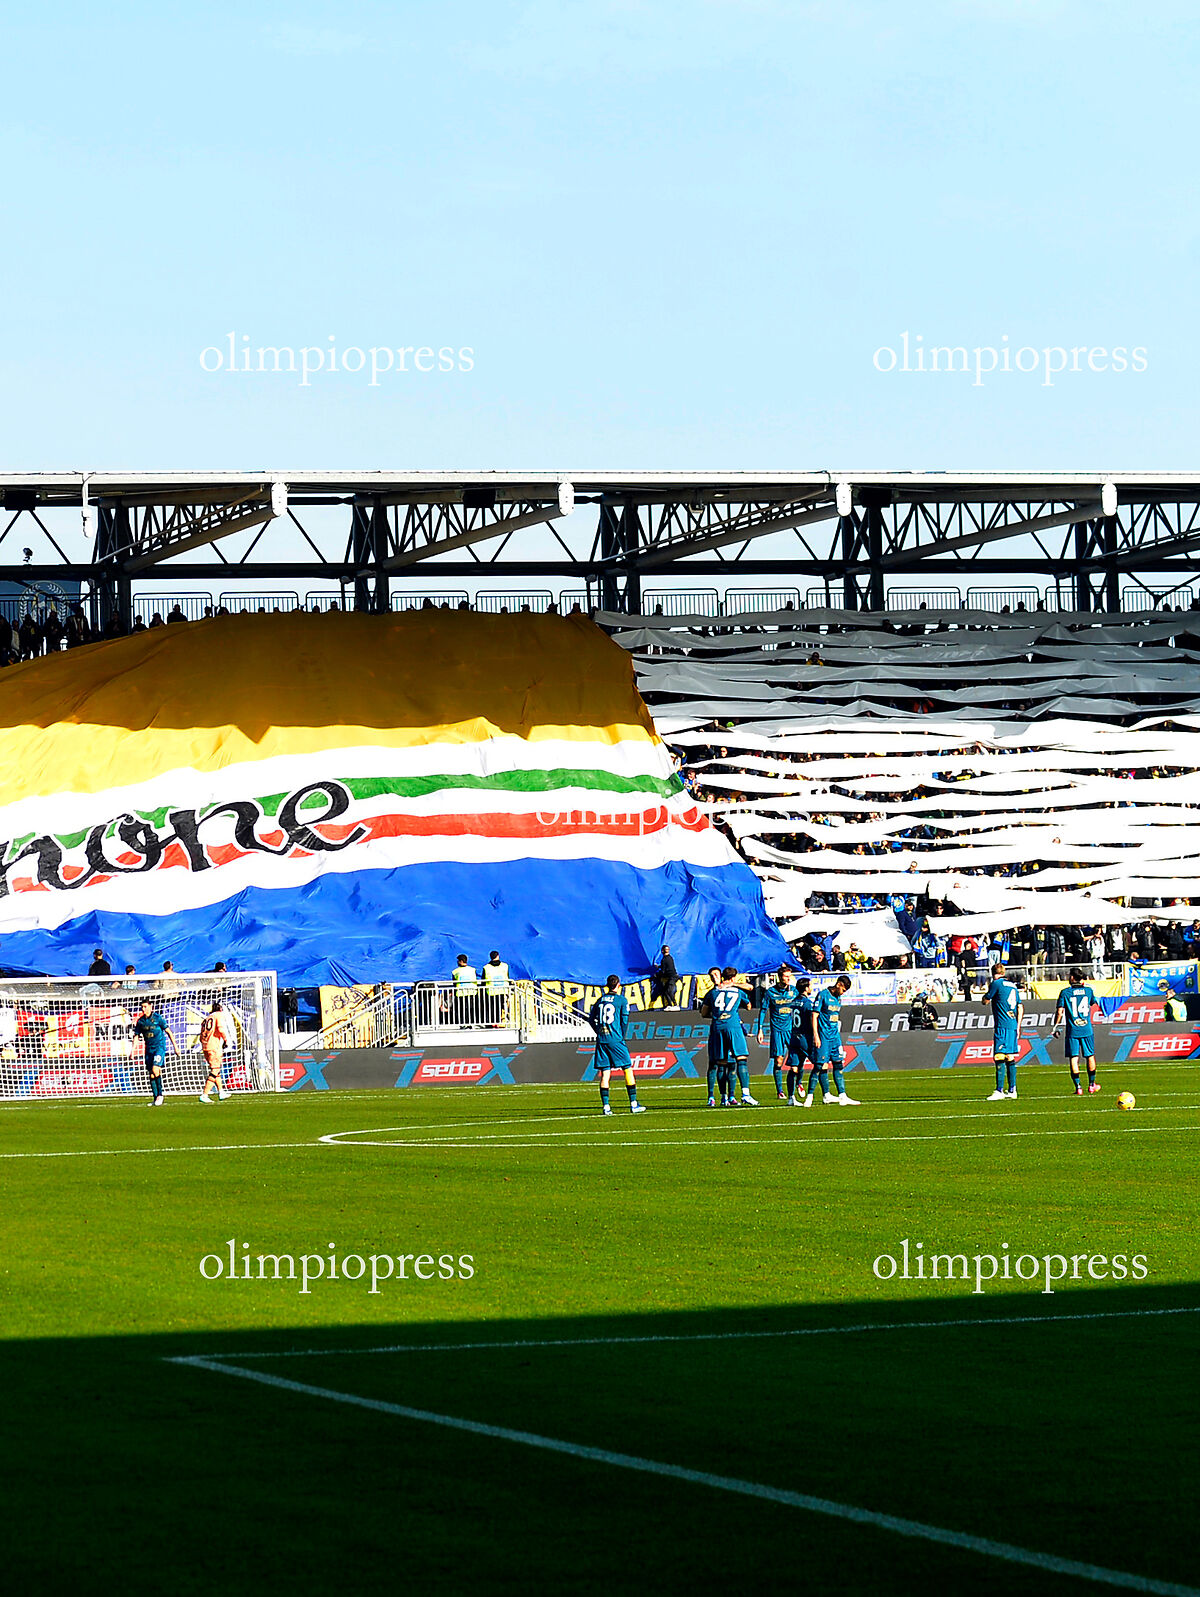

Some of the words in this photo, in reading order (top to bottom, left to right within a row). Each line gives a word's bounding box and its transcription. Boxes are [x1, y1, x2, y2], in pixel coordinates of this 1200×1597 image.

[1131, 965, 1195, 978] AMASENO
[714, 991, 739, 1012] 47
[1007, 988, 1017, 1010] 4
[1069, 996, 1090, 1017] 14
[598, 1003, 616, 1025] 18
[852, 1014, 880, 1033] la
[1137, 1036, 1192, 1053] sette
[421, 1061, 482, 1077] sette
